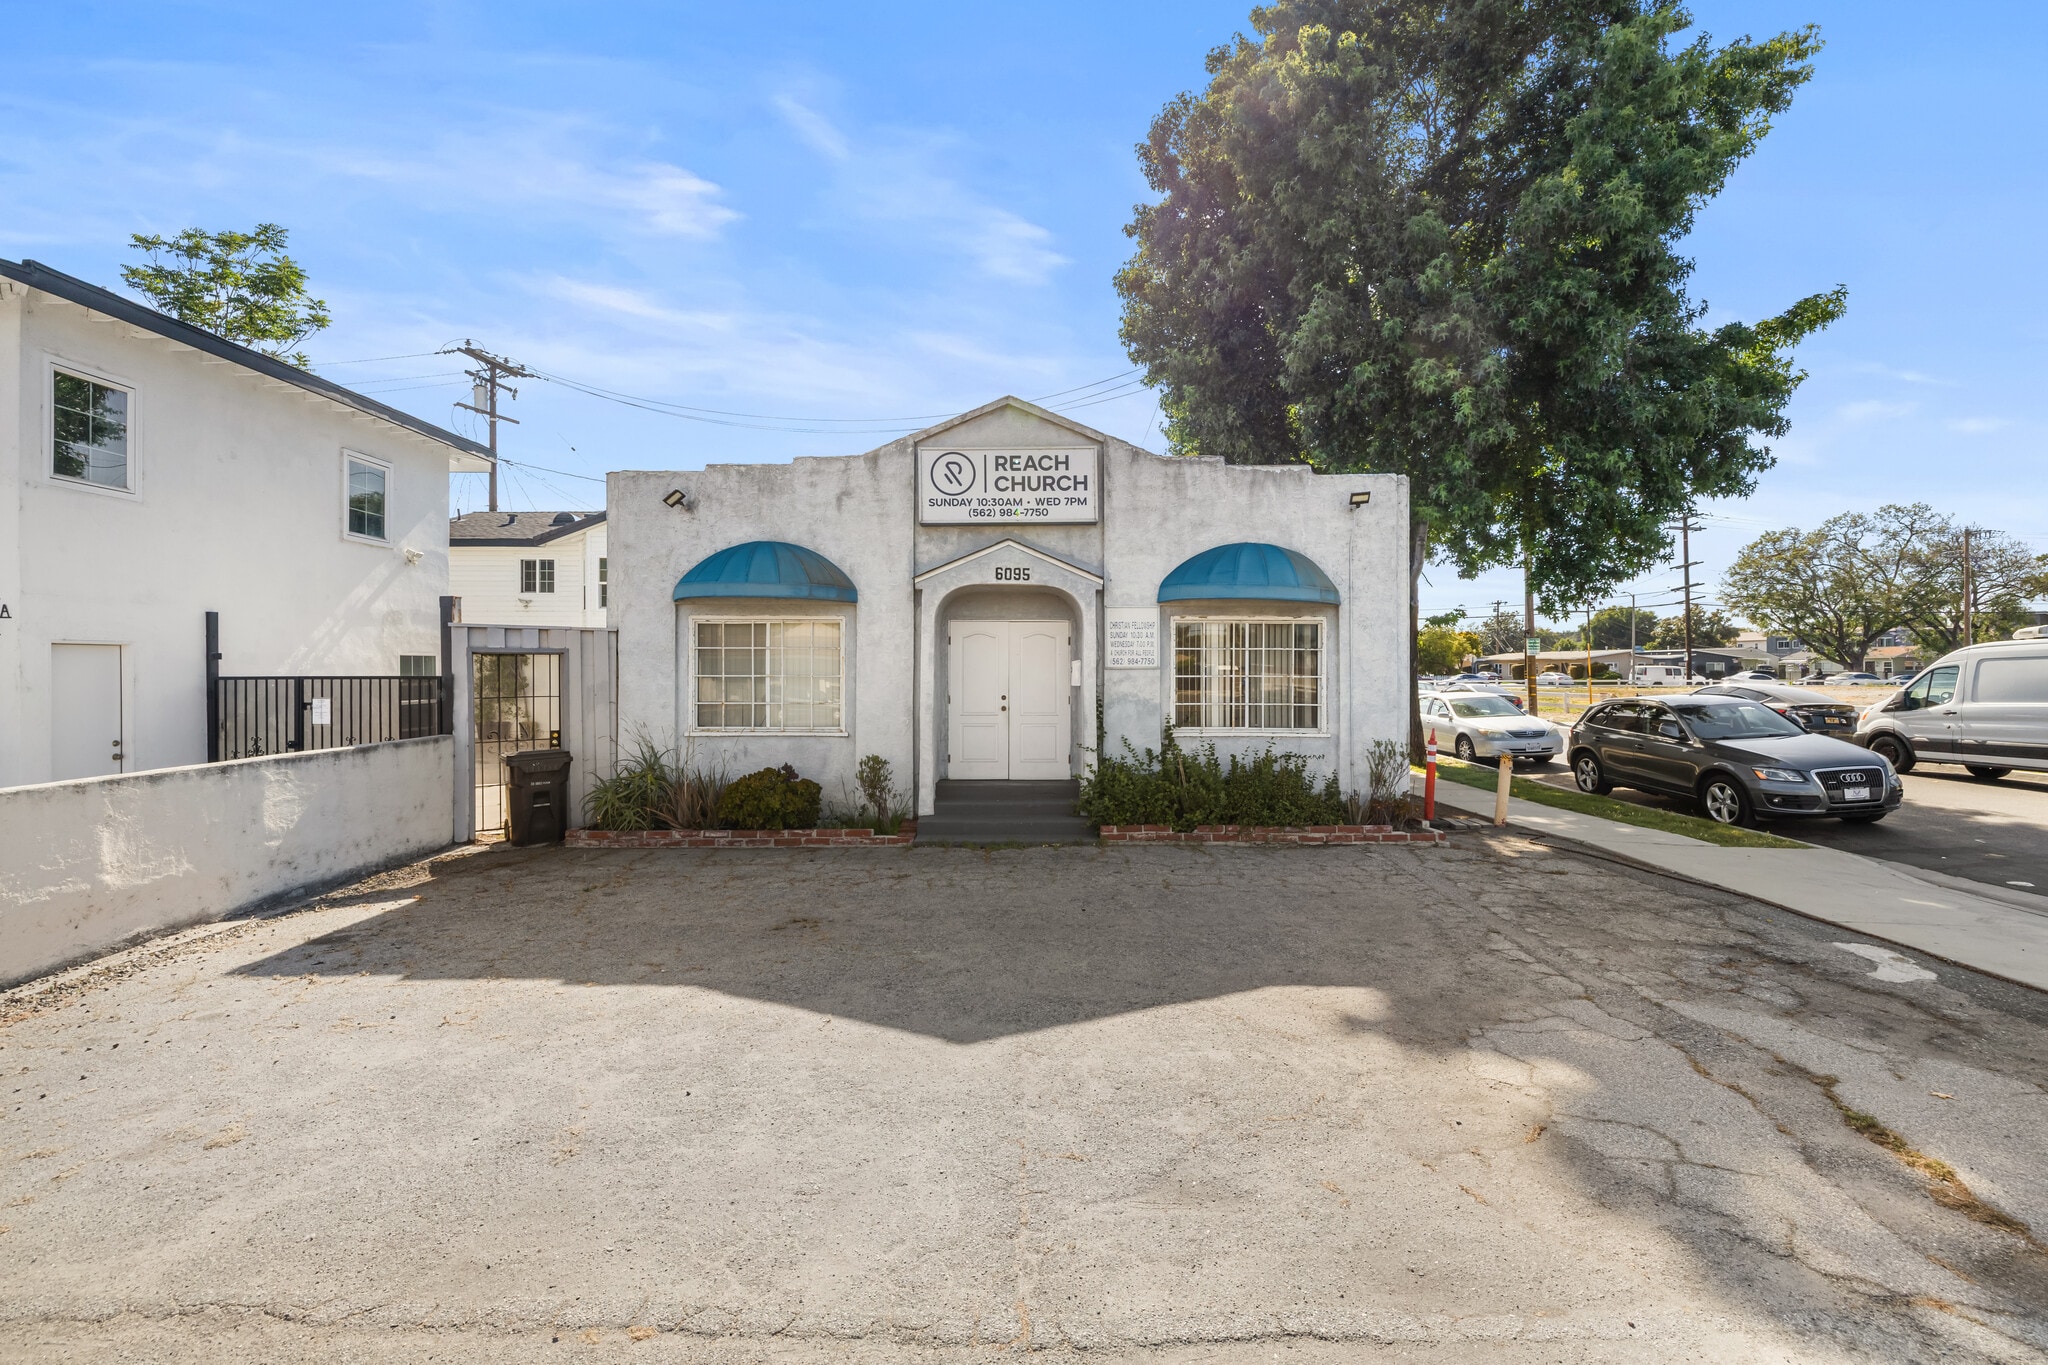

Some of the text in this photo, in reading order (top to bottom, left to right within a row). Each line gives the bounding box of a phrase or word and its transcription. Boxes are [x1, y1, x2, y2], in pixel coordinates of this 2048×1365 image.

[994, 455, 1069, 472] REACH
[994, 475, 1088, 492] CHURCH
[928, 497, 1088, 507] SUNDAY 10:30AM WED 7PM
[968, 508, 1049, 518] (562) 984-7750
[995, 567, 1031, 581] 6095
